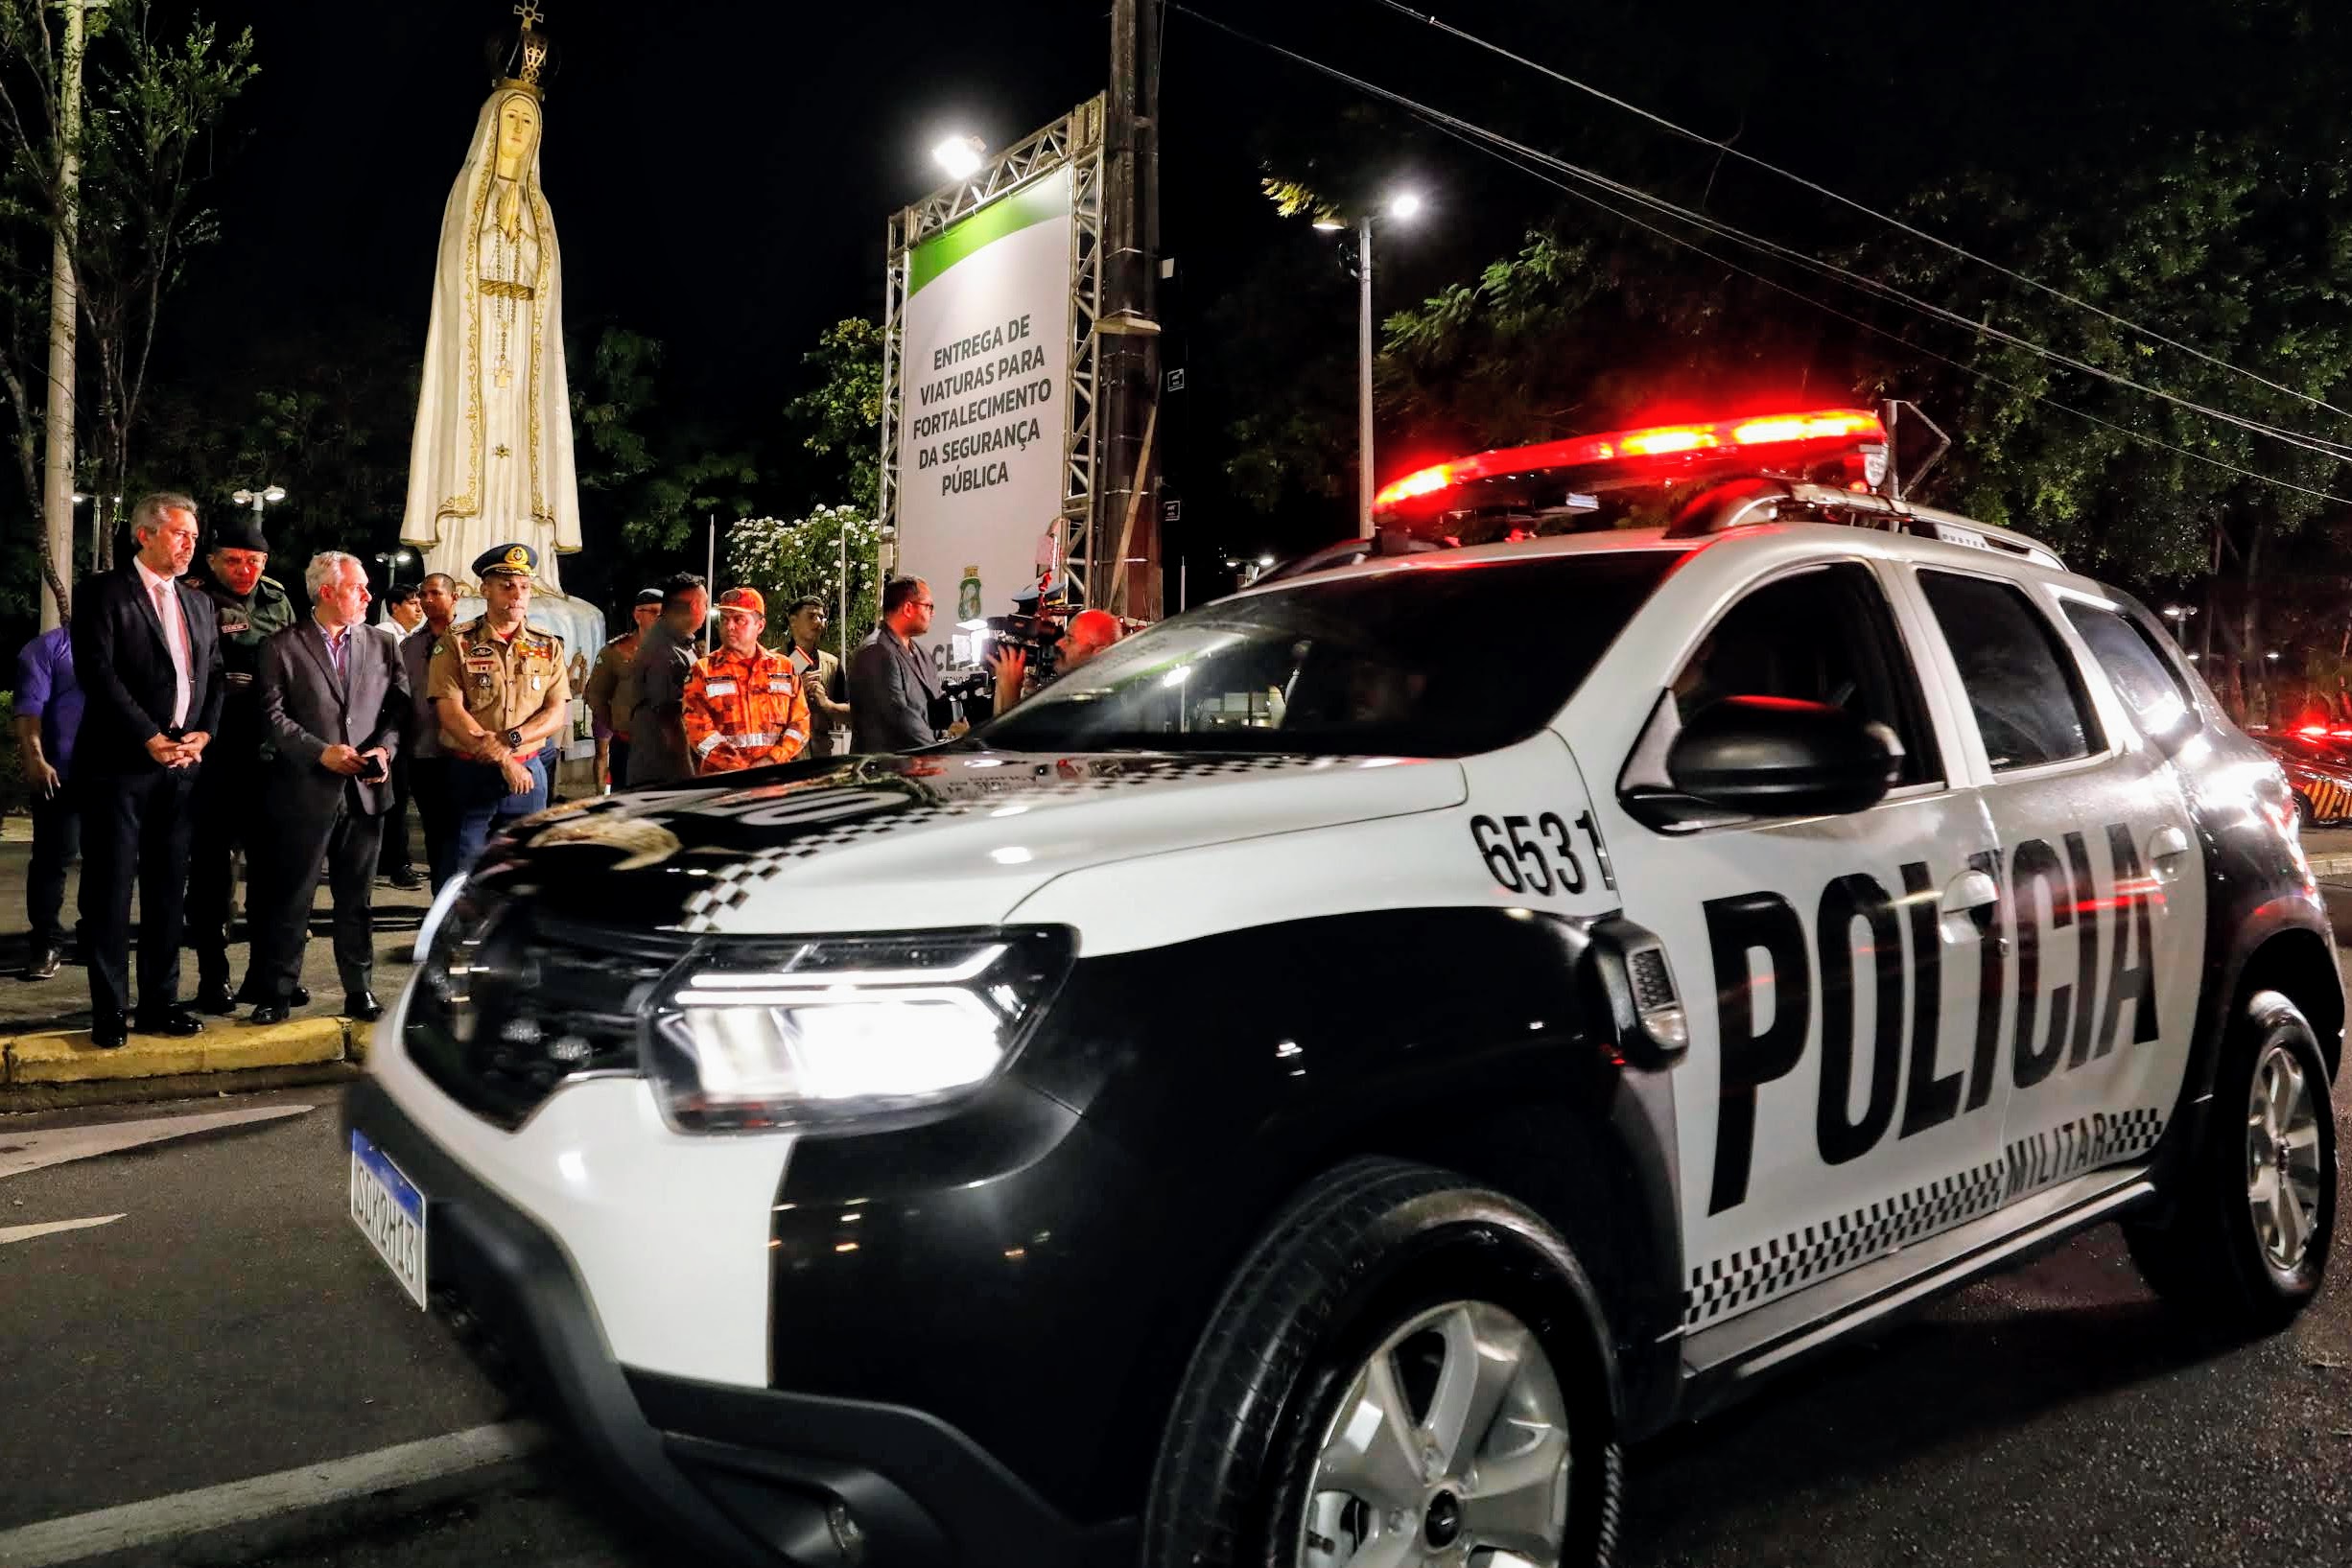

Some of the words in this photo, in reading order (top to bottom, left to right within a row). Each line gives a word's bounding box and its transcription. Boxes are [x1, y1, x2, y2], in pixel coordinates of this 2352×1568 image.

[933, 326, 1003, 370] ENTREGA
[1008, 314, 1030, 343] DE
[920, 362, 995, 407] VIATURAS
[998, 345, 1045, 381] PARA
[913, 378, 1052, 440] FORTALECIMENTO
[918, 446, 939, 470] DA
[941, 417, 1041, 464] SEGURANÇA
[941, 460, 1009, 497] PÚBLICA
[1470, 809, 1617, 897] 6531
[2004, 1112, 2106, 1200] MILITAR
